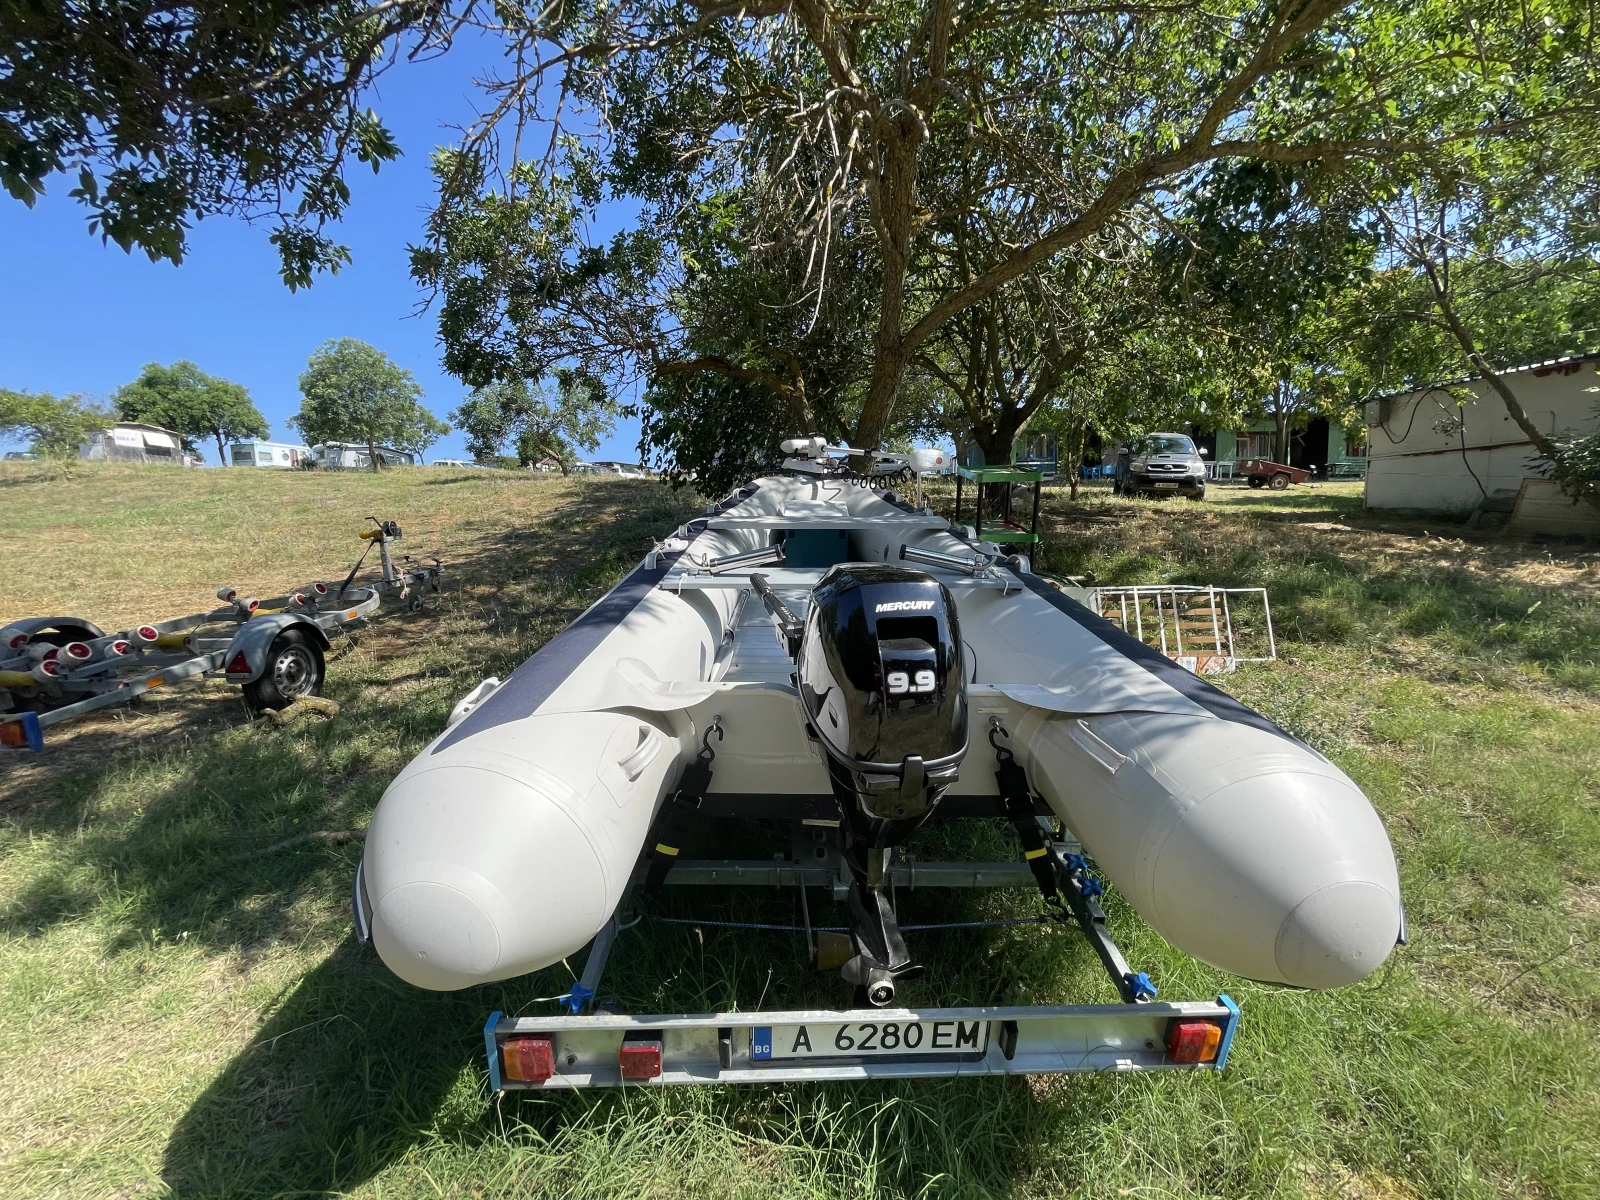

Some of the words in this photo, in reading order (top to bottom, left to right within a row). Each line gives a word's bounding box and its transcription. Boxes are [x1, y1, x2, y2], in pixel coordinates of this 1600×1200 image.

[875, 601, 935, 613] MERCURY
[887, 669, 936, 694] 9.9
[791, 1025, 813, 1053] A
[834, 1022, 924, 1051] 6280
[931, 1021, 980, 1049] EM
[754, 1045, 770, 1054] BG
